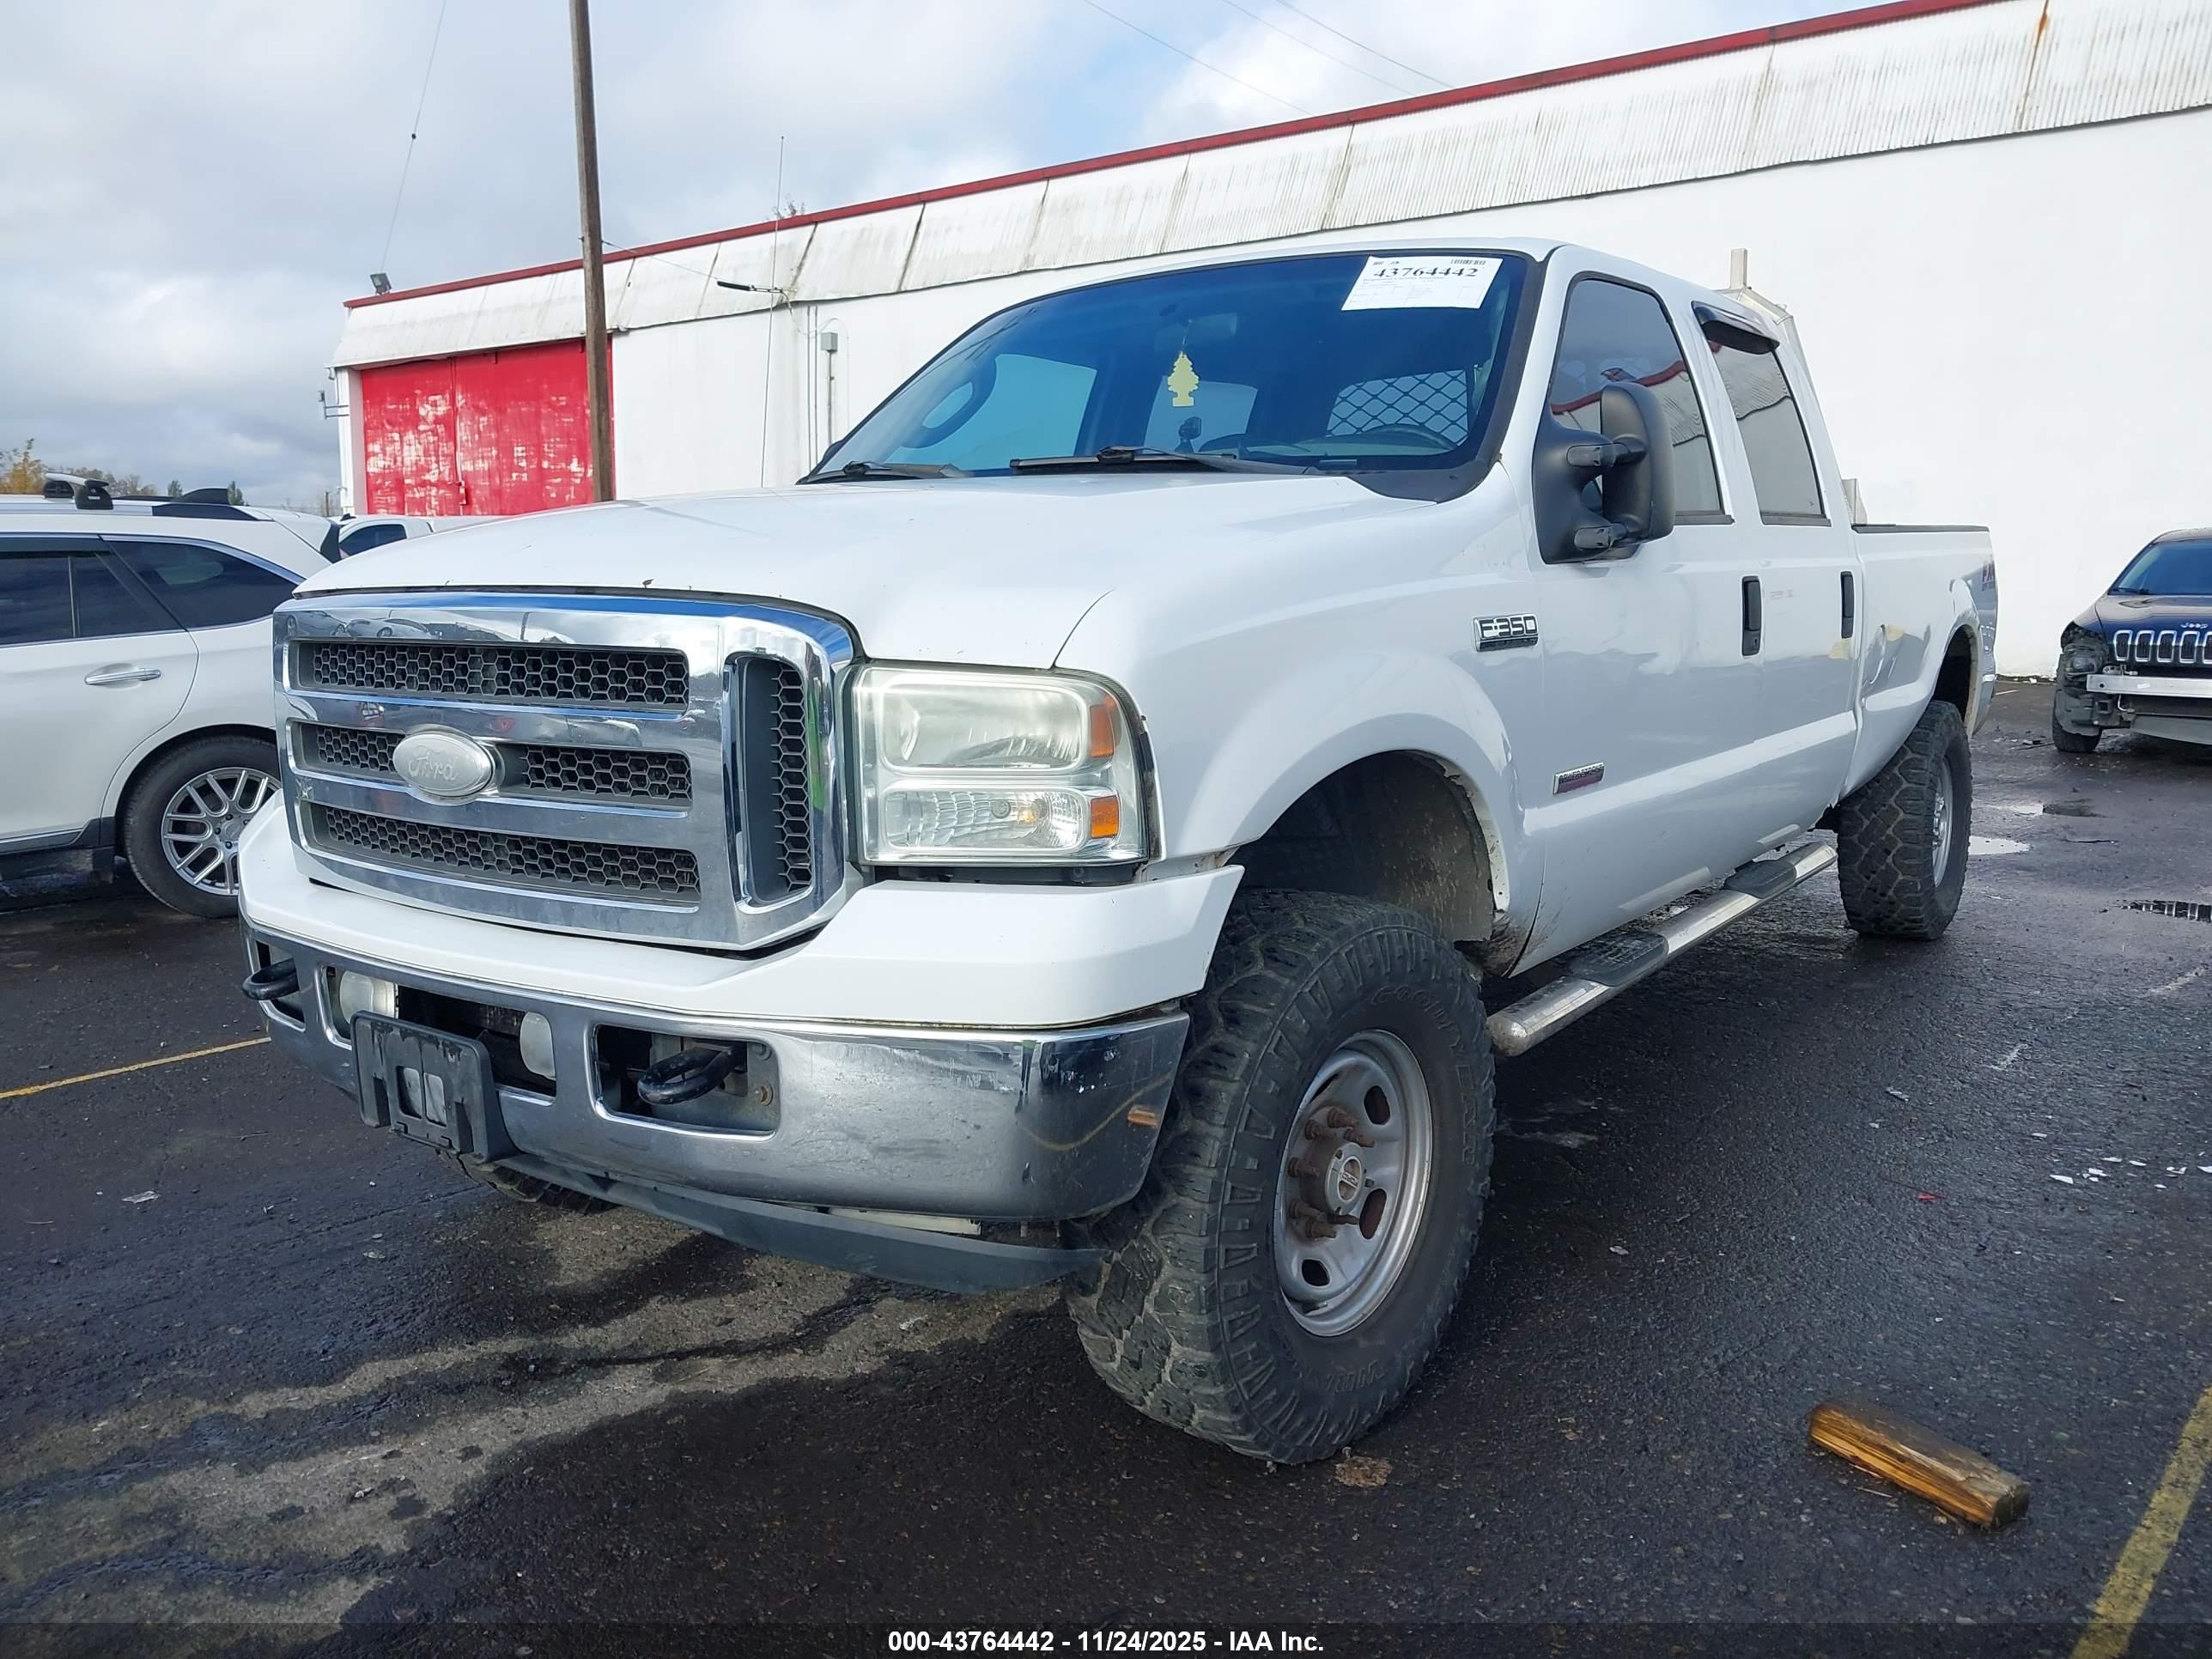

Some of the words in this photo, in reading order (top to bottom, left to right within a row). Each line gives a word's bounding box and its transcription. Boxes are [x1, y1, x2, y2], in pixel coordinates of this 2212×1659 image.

[1374, 267, 1479, 278] 43764442
[1479, 615, 1538, 639] F-350
[408, 746, 460, 781] Ford
